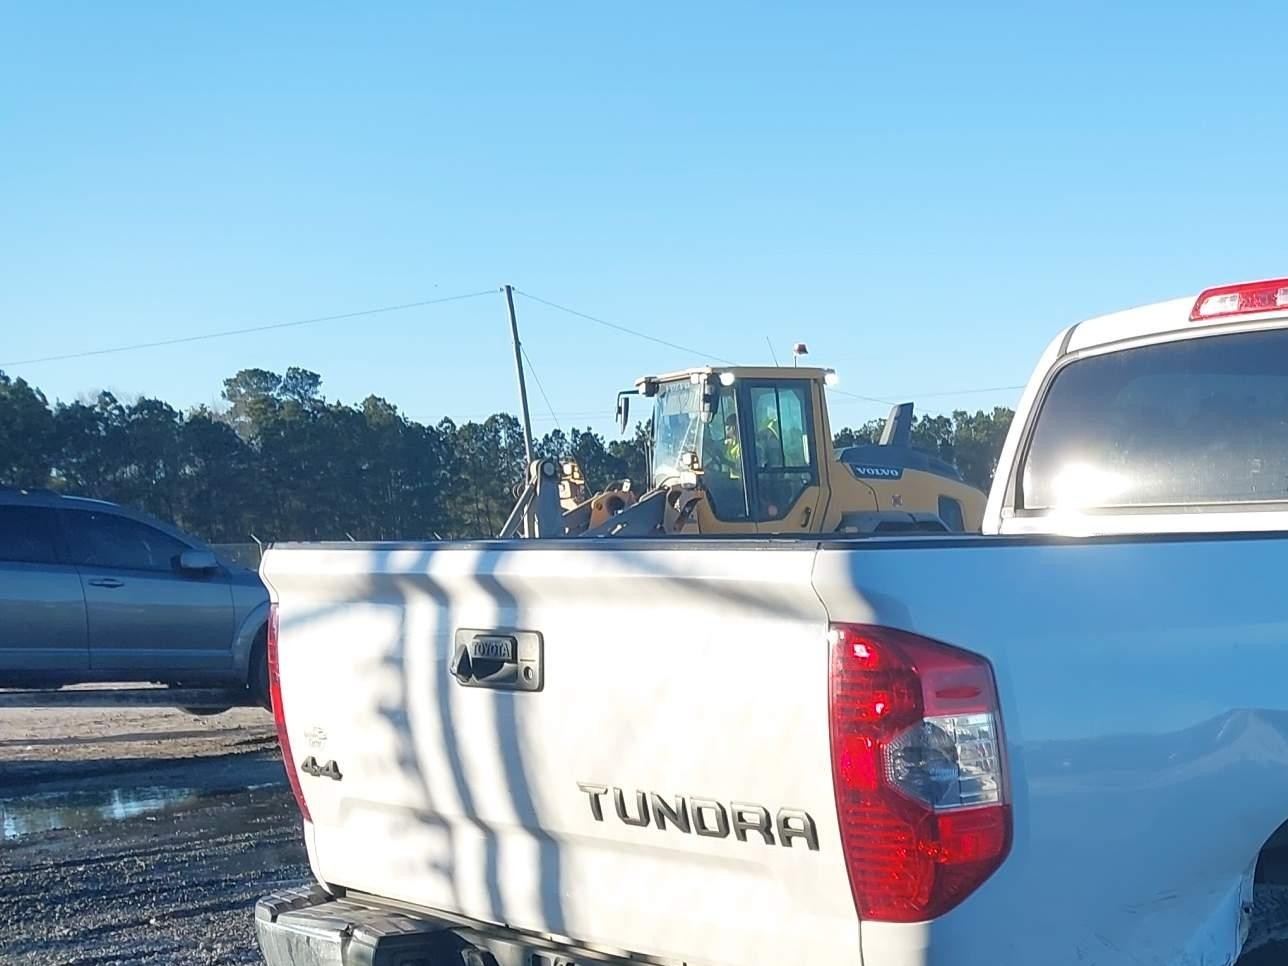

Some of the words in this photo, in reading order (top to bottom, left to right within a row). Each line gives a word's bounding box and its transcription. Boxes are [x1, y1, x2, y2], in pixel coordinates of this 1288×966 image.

[856, 467, 899, 477] VOLVO
[473, 639, 511, 658] TOYOTA
[576, 781, 820, 851] TUNDRA
